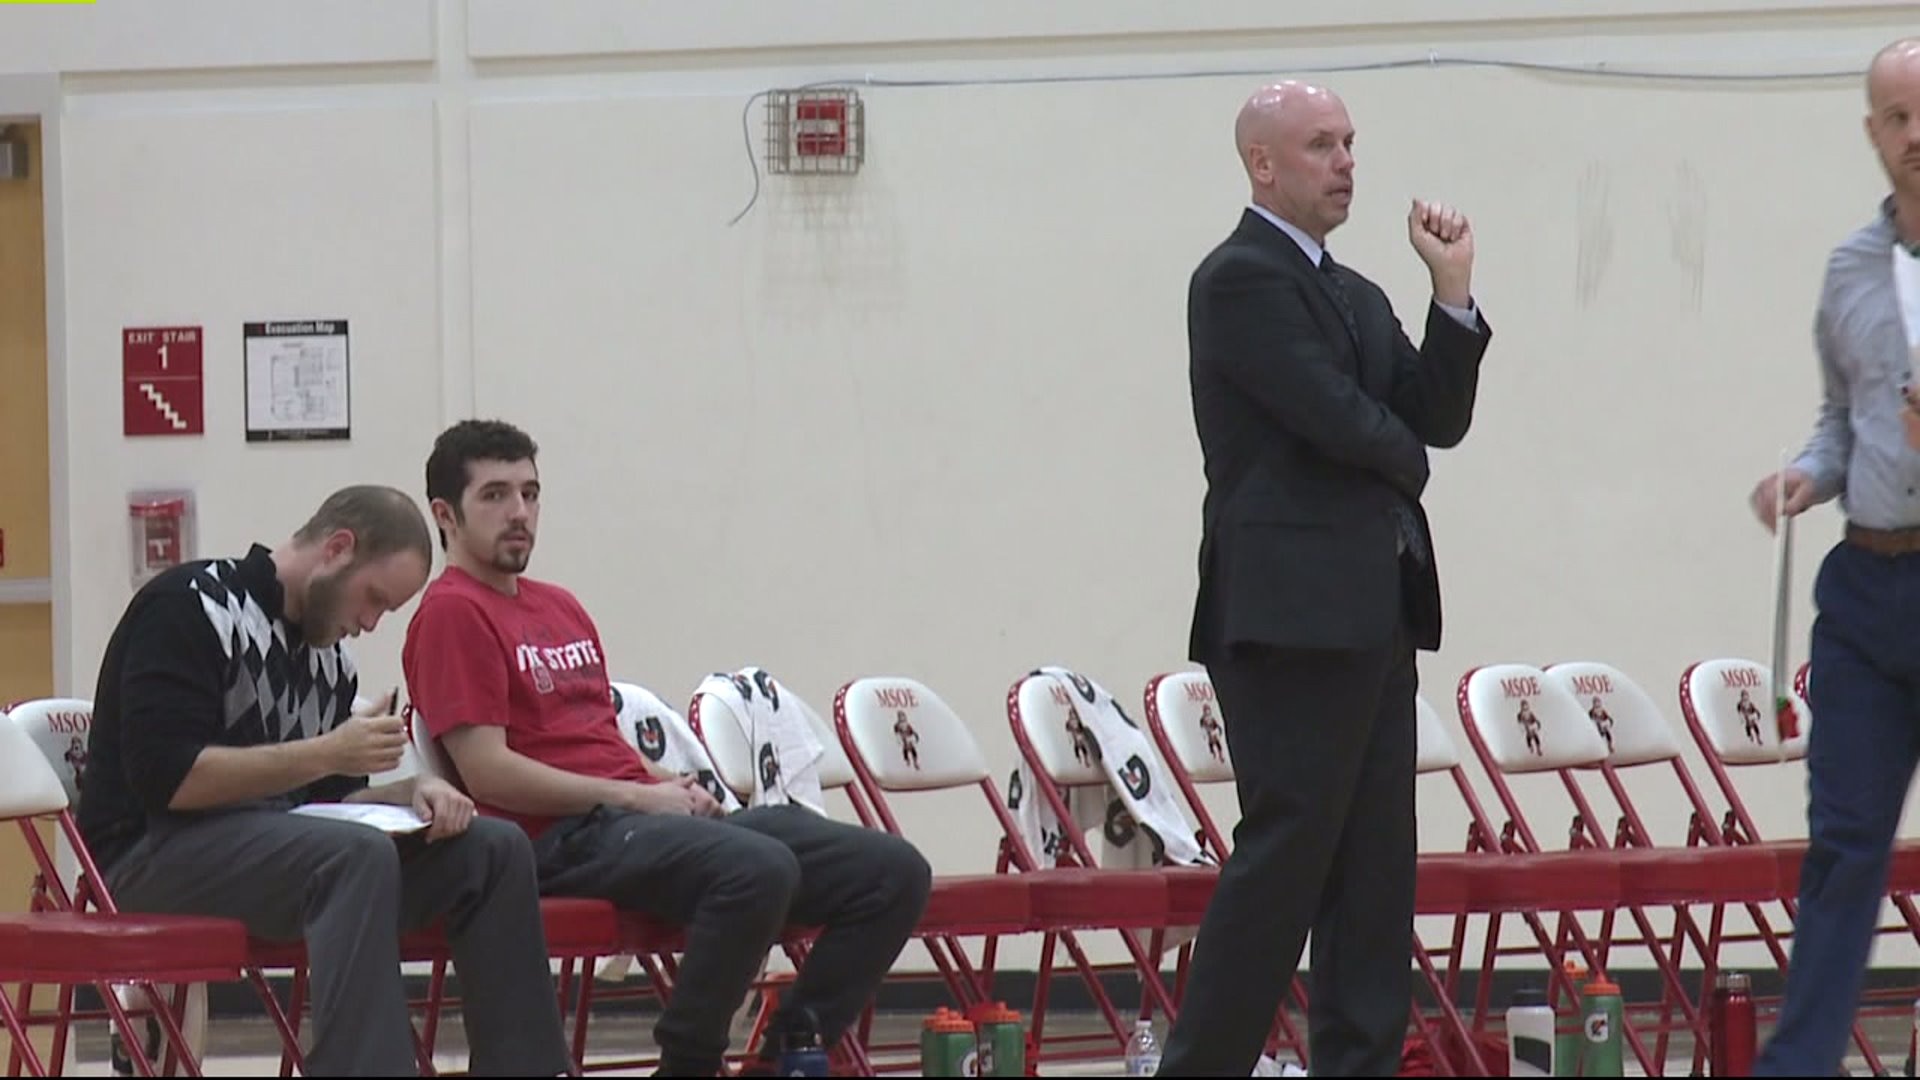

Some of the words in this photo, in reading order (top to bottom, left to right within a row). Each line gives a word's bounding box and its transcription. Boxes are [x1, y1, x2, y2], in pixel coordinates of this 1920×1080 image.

[128, 331, 154, 344] EXIT
[162, 329, 196, 343] STAIR
[265, 320, 314, 335] Evacuation
[315, 319, 335, 335] Map
[157, 345, 168, 369] 1
[543, 639, 600, 670] STATE
[1499, 676, 1541, 698] MSOE
[1571, 675, 1613, 695] MSOE
[1719, 668, 1761, 688] MSOE
[873, 687, 919, 708] MSOE
[1048, 683, 1071, 706] MS
[1181, 682, 1216, 702] MSO
